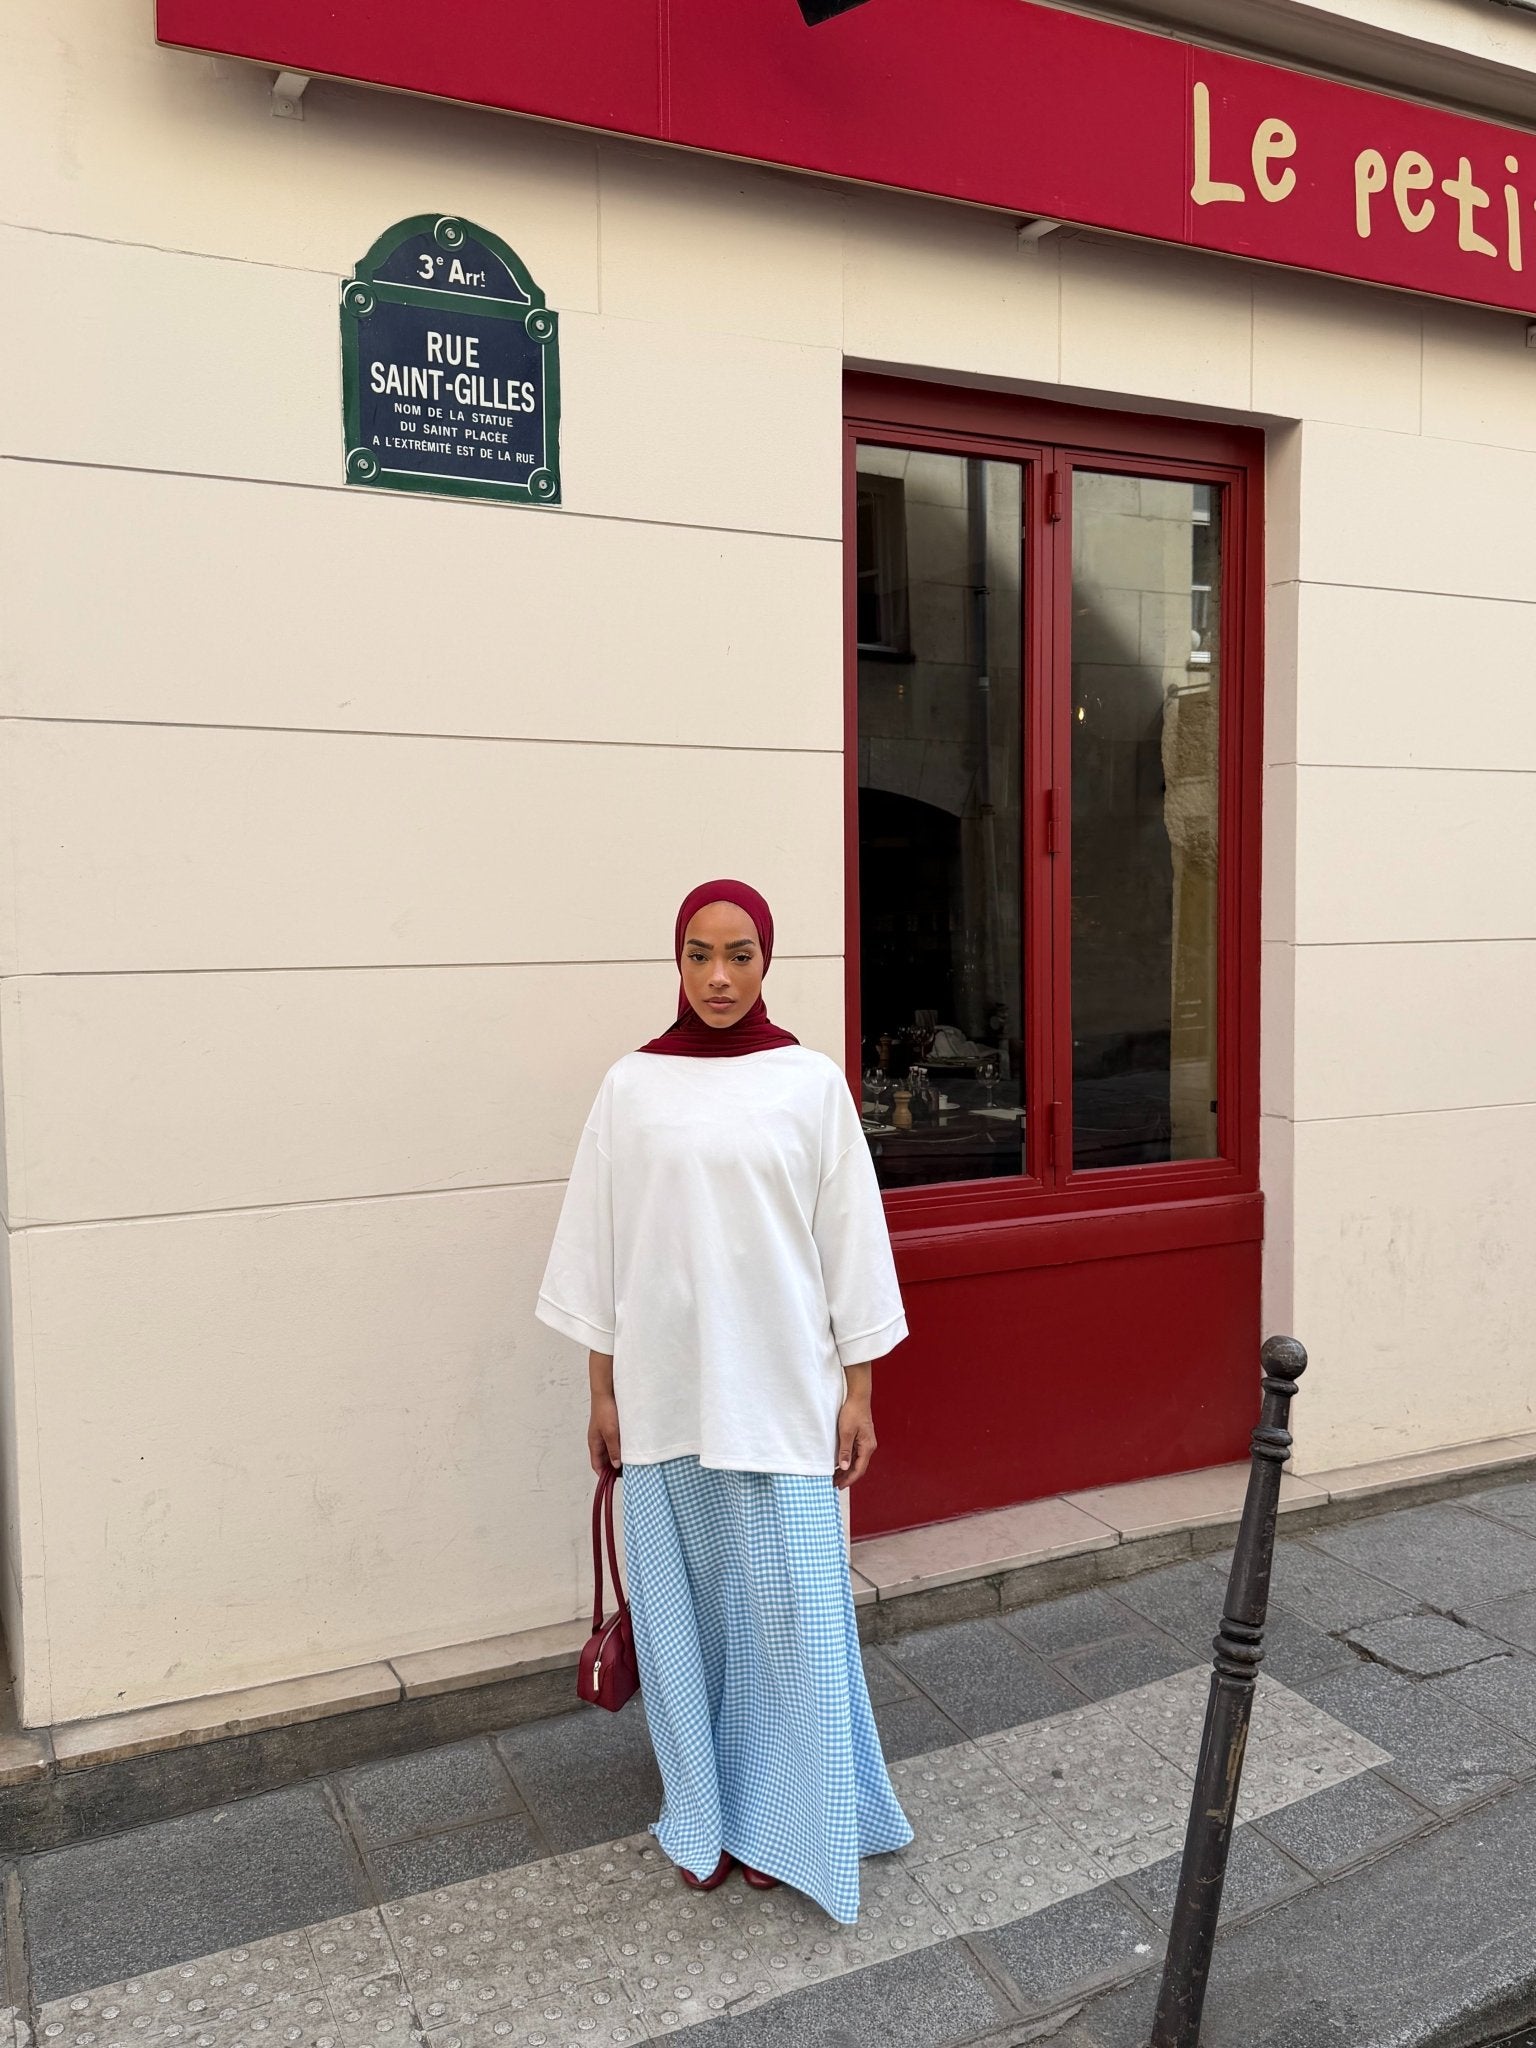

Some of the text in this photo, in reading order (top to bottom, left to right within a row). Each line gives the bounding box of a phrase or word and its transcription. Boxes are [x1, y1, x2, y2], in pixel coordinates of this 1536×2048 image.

[1190, 81, 1536, 272] Le peti
[427, 331, 480, 368] RUE
[370, 361, 535, 413] SAINT-GILLES
[394, 402, 514, 428] NOM DE LA STATUE
[400, 421, 416, 433] DU
[423, 424, 458, 438] SAINT
[457, 445, 475, 457] EST
[480, 448, 493, 459] DE
[498, 450, 511, 462] LA
[516, 452, 535, 464] RUE
